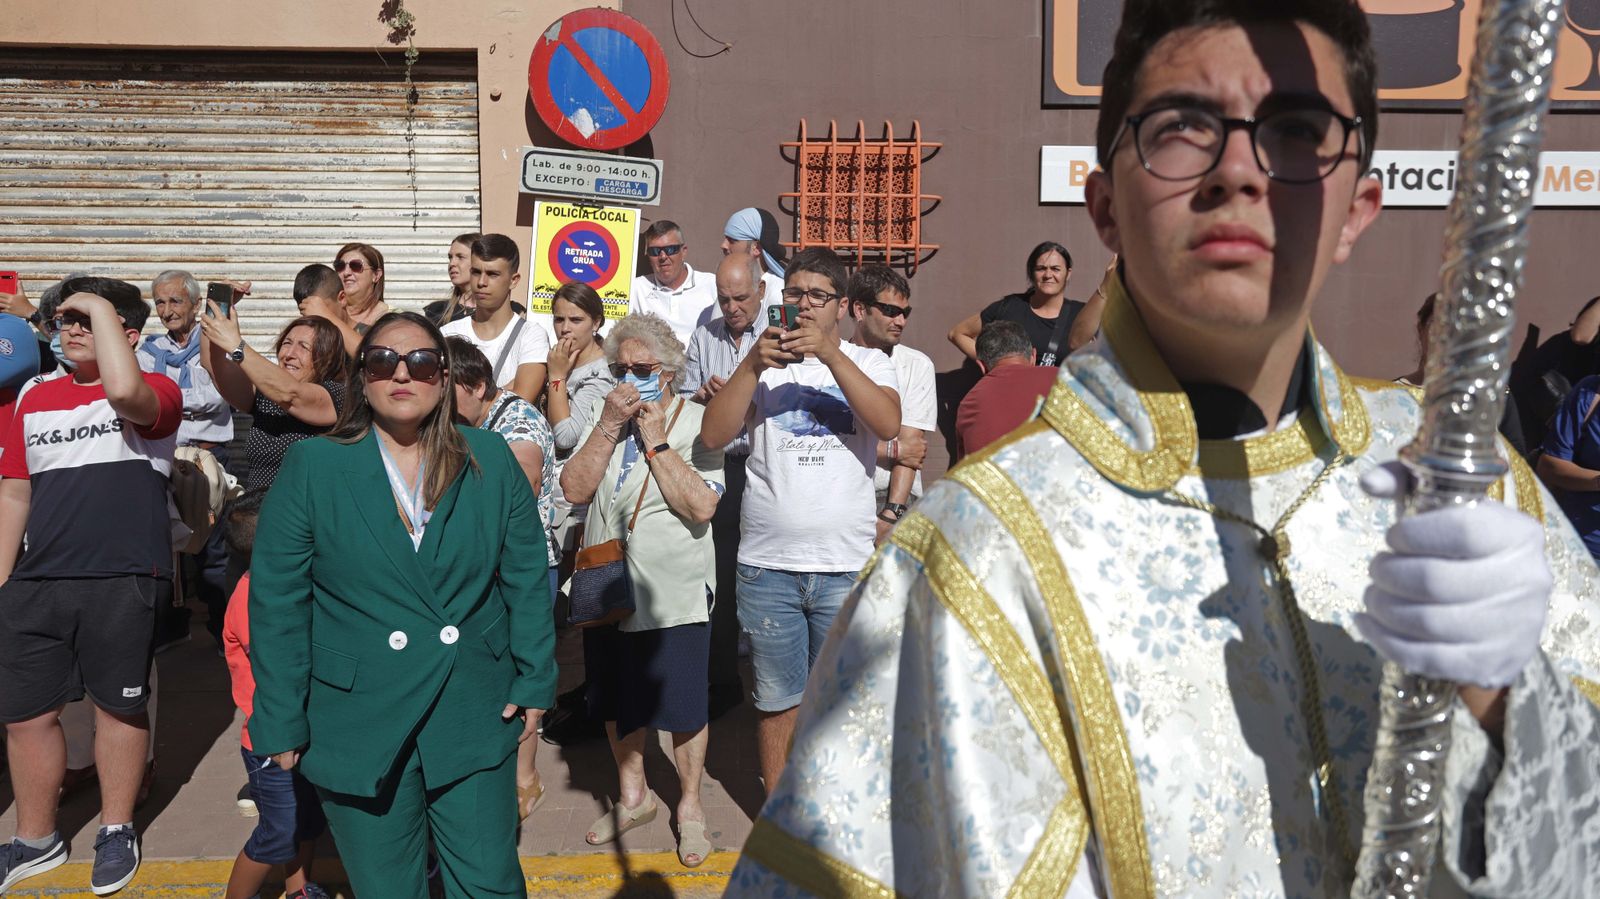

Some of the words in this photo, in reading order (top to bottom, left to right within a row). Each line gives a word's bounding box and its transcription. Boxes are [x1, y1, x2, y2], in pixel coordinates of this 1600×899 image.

[532, 158, 555, 169] Lab.
[559, 162, 572, 171] de
[641, 170, 651, 179] h.
[603, 179, 631, 189] CARGA
[599, 185, 643, 196] DESCARGA
[593, 210, 629, 223] LOCAL
[565, 247, 604, 258] RETIRADA
[776, 437, 805, 453] State
[807, 442, 817, 455] of
